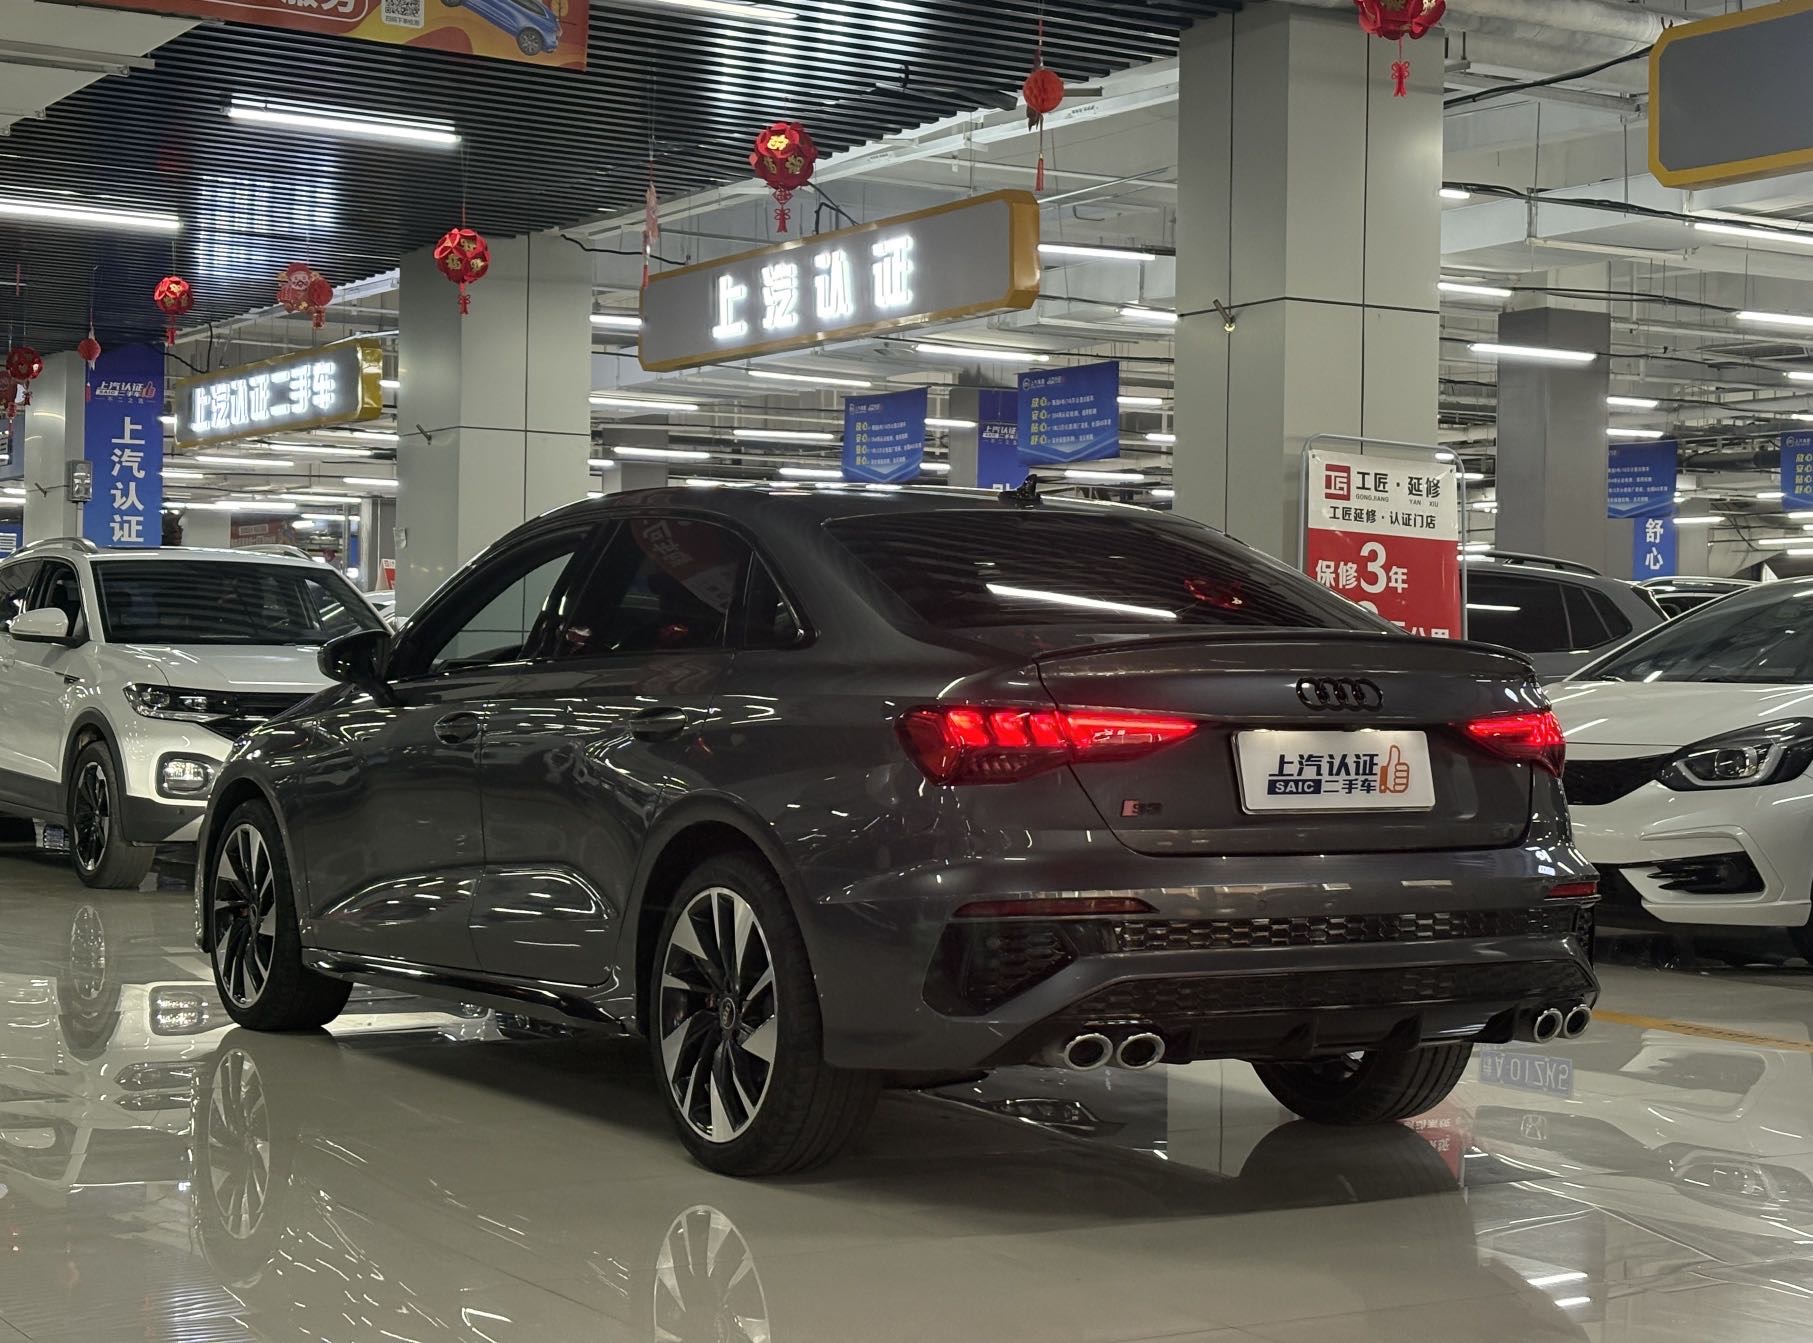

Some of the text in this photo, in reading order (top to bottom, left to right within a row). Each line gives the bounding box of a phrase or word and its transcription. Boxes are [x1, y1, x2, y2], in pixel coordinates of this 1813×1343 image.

[712, 235, 914, 339] 上汽认证
[101, 381, 144, 391] 上汽认证
[190, 361, 336, 432] 上汽认证二手车
[110, 416, 145, 542] 上汽认证
[1315, 541, 1409, 593] 保修3年
[1645, 518, 1664, 570] 舒心
[1268, 754, 1379, 777] 上汽认证
[1275, 779, 1377, 794] SAIC 二手车
